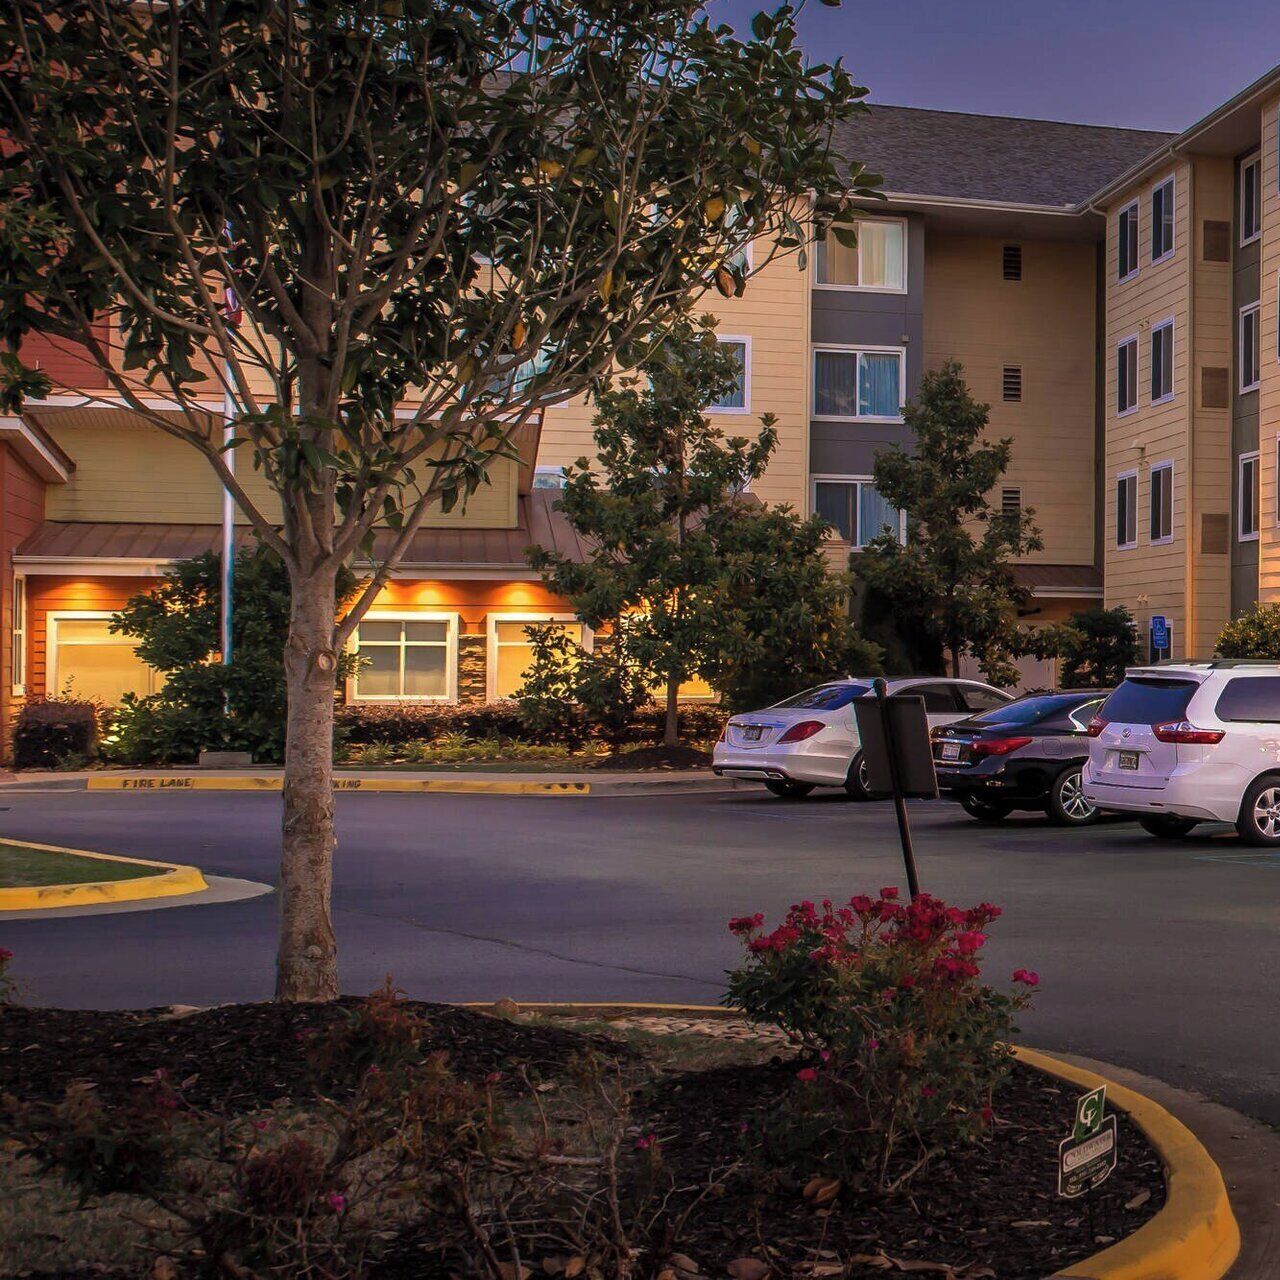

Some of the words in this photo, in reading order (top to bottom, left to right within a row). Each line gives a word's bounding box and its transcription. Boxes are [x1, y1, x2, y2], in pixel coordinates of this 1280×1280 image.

[123, 779, 157, 788] FIRE
[160, 778, 192, 788] LANE
[331, 779, 362, 789] KING
